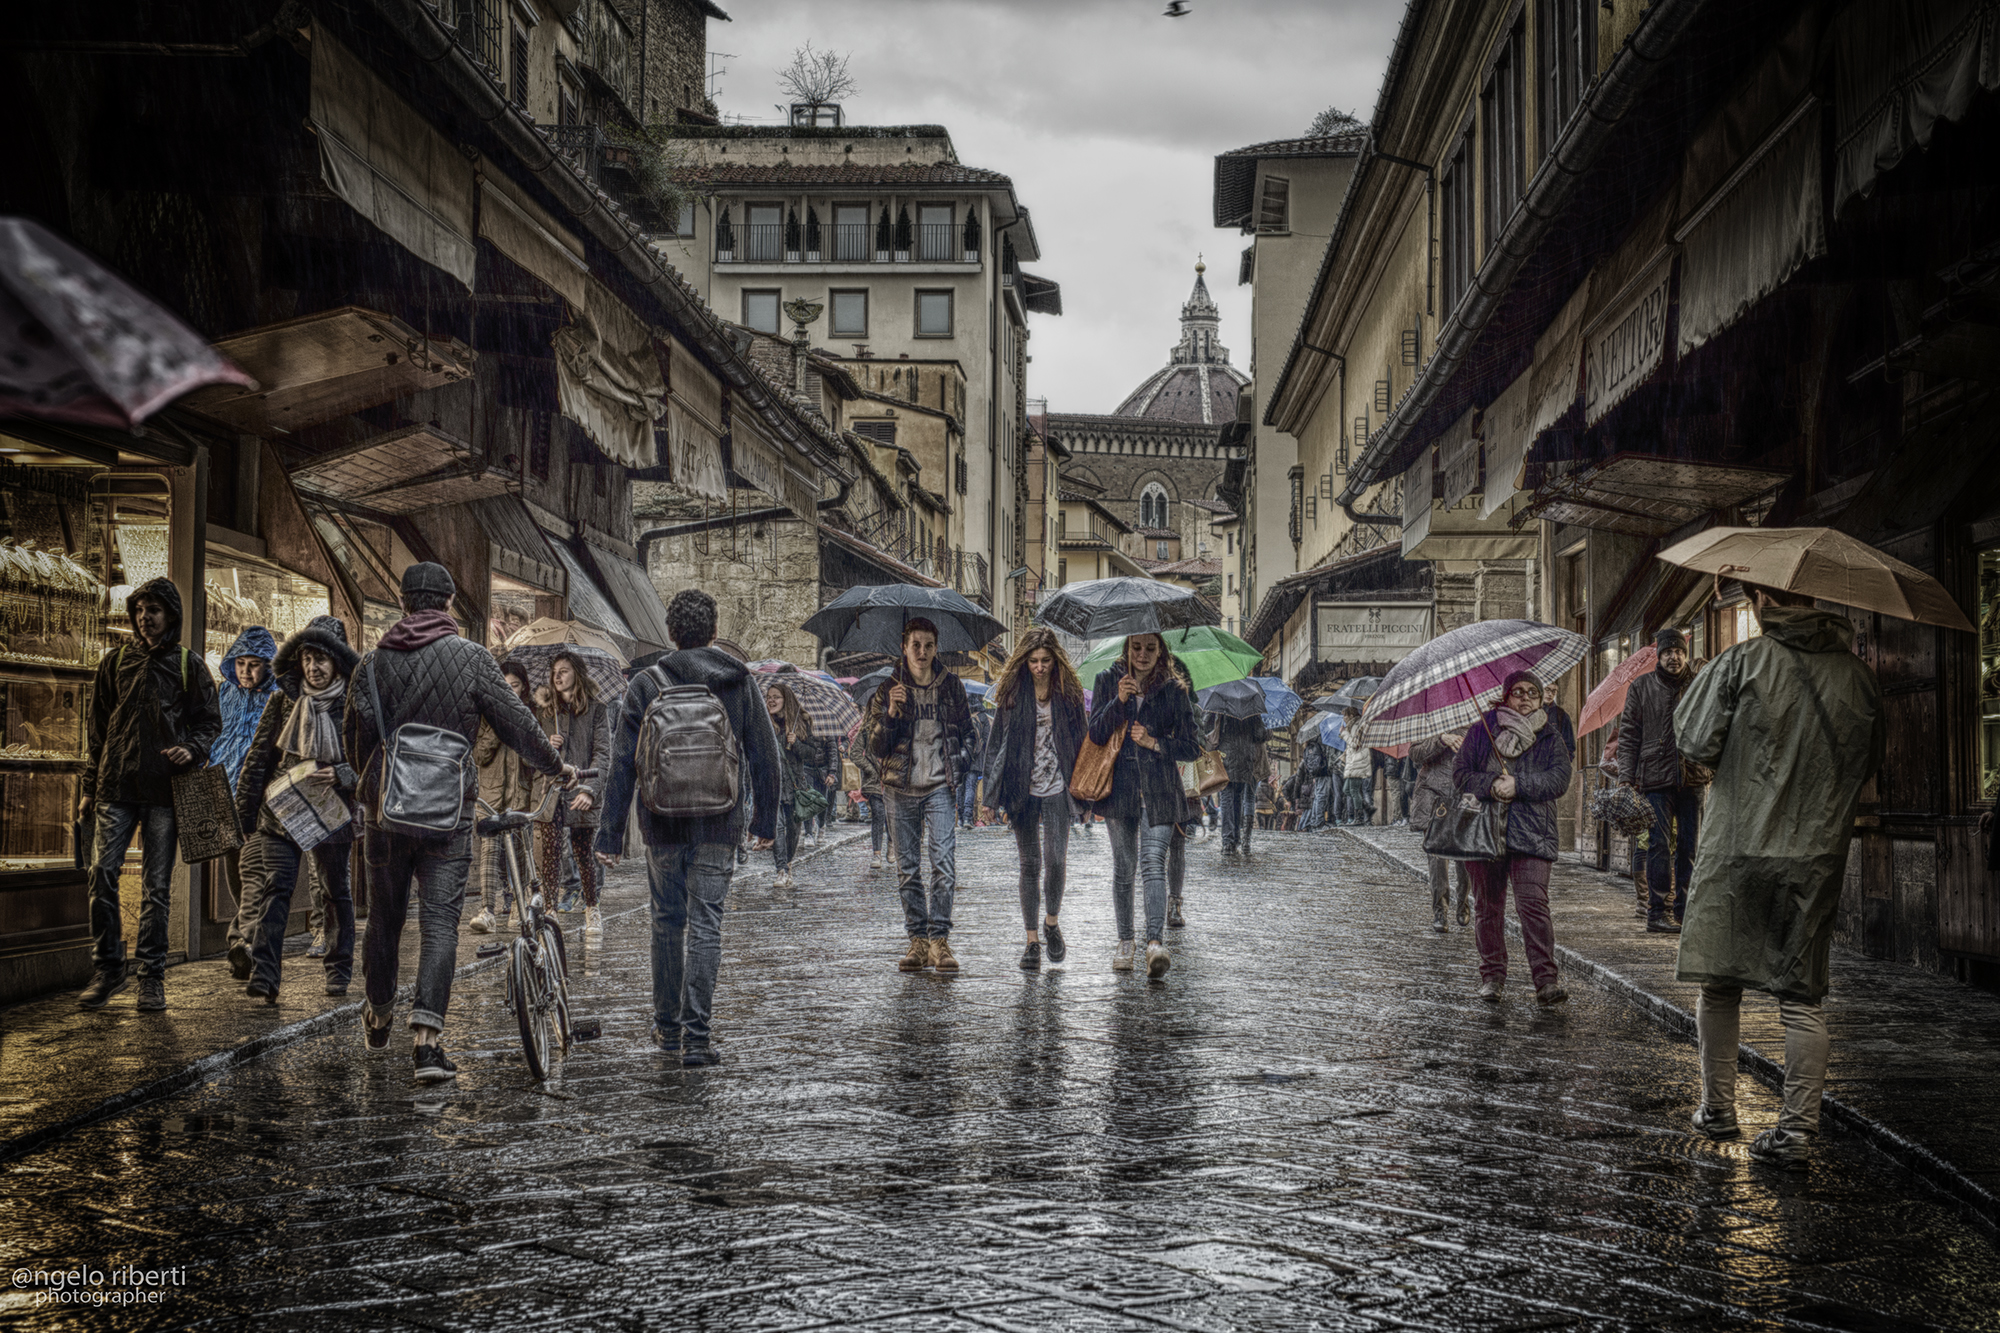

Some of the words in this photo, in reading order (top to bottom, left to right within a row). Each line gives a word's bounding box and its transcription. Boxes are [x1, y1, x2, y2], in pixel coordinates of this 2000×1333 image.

[20, 462, 56, 494] GOLD
[1327, 624, 1379, 633] FRATELLI
[1381, 624, 1423, 633] PICCINI
